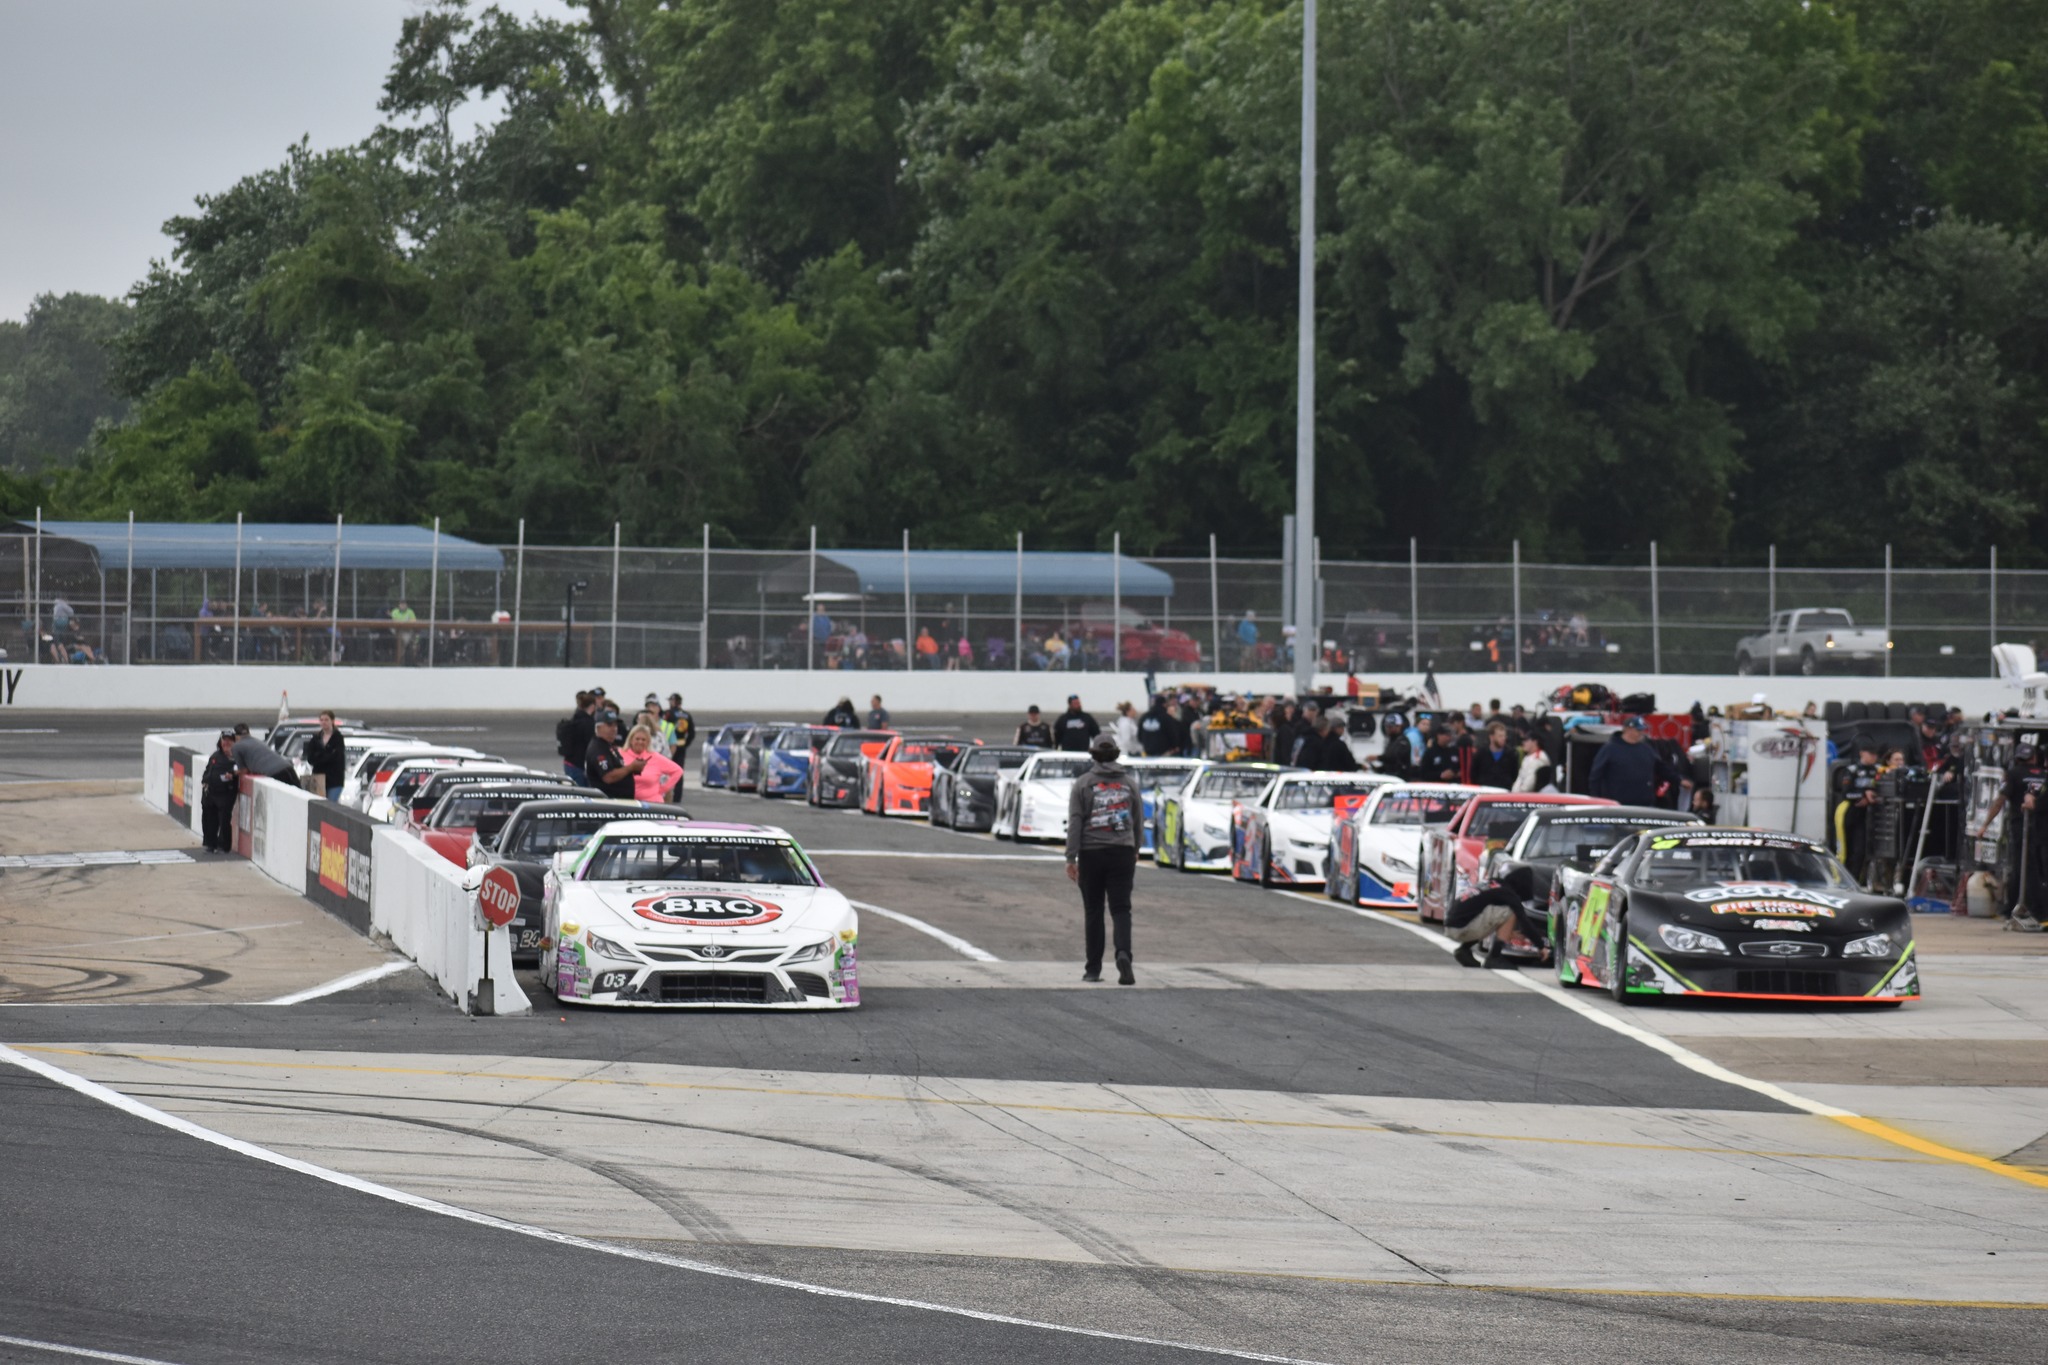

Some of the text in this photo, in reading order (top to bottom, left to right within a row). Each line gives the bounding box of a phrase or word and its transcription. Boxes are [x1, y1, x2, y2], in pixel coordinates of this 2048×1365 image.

[1630, 818, 1686, 827] CARRIERS
[711, 837, 776, 846] CARRIERS
[1664, 832, 1709, 840] SOLID
[1754, 832, 1818, 846] CARRIERS
[1686, 838, 1763, 847] SMITH
[481, 878, 518, 914] STOP
[662, 898, 754, 914] BRC
[1714, 901, 1832, 917] FIREHOUSE
[1755, 905, 1799, 914] SUBS
[520, 930, 541, 948] 24
[602, 973, 627, 988] 03
